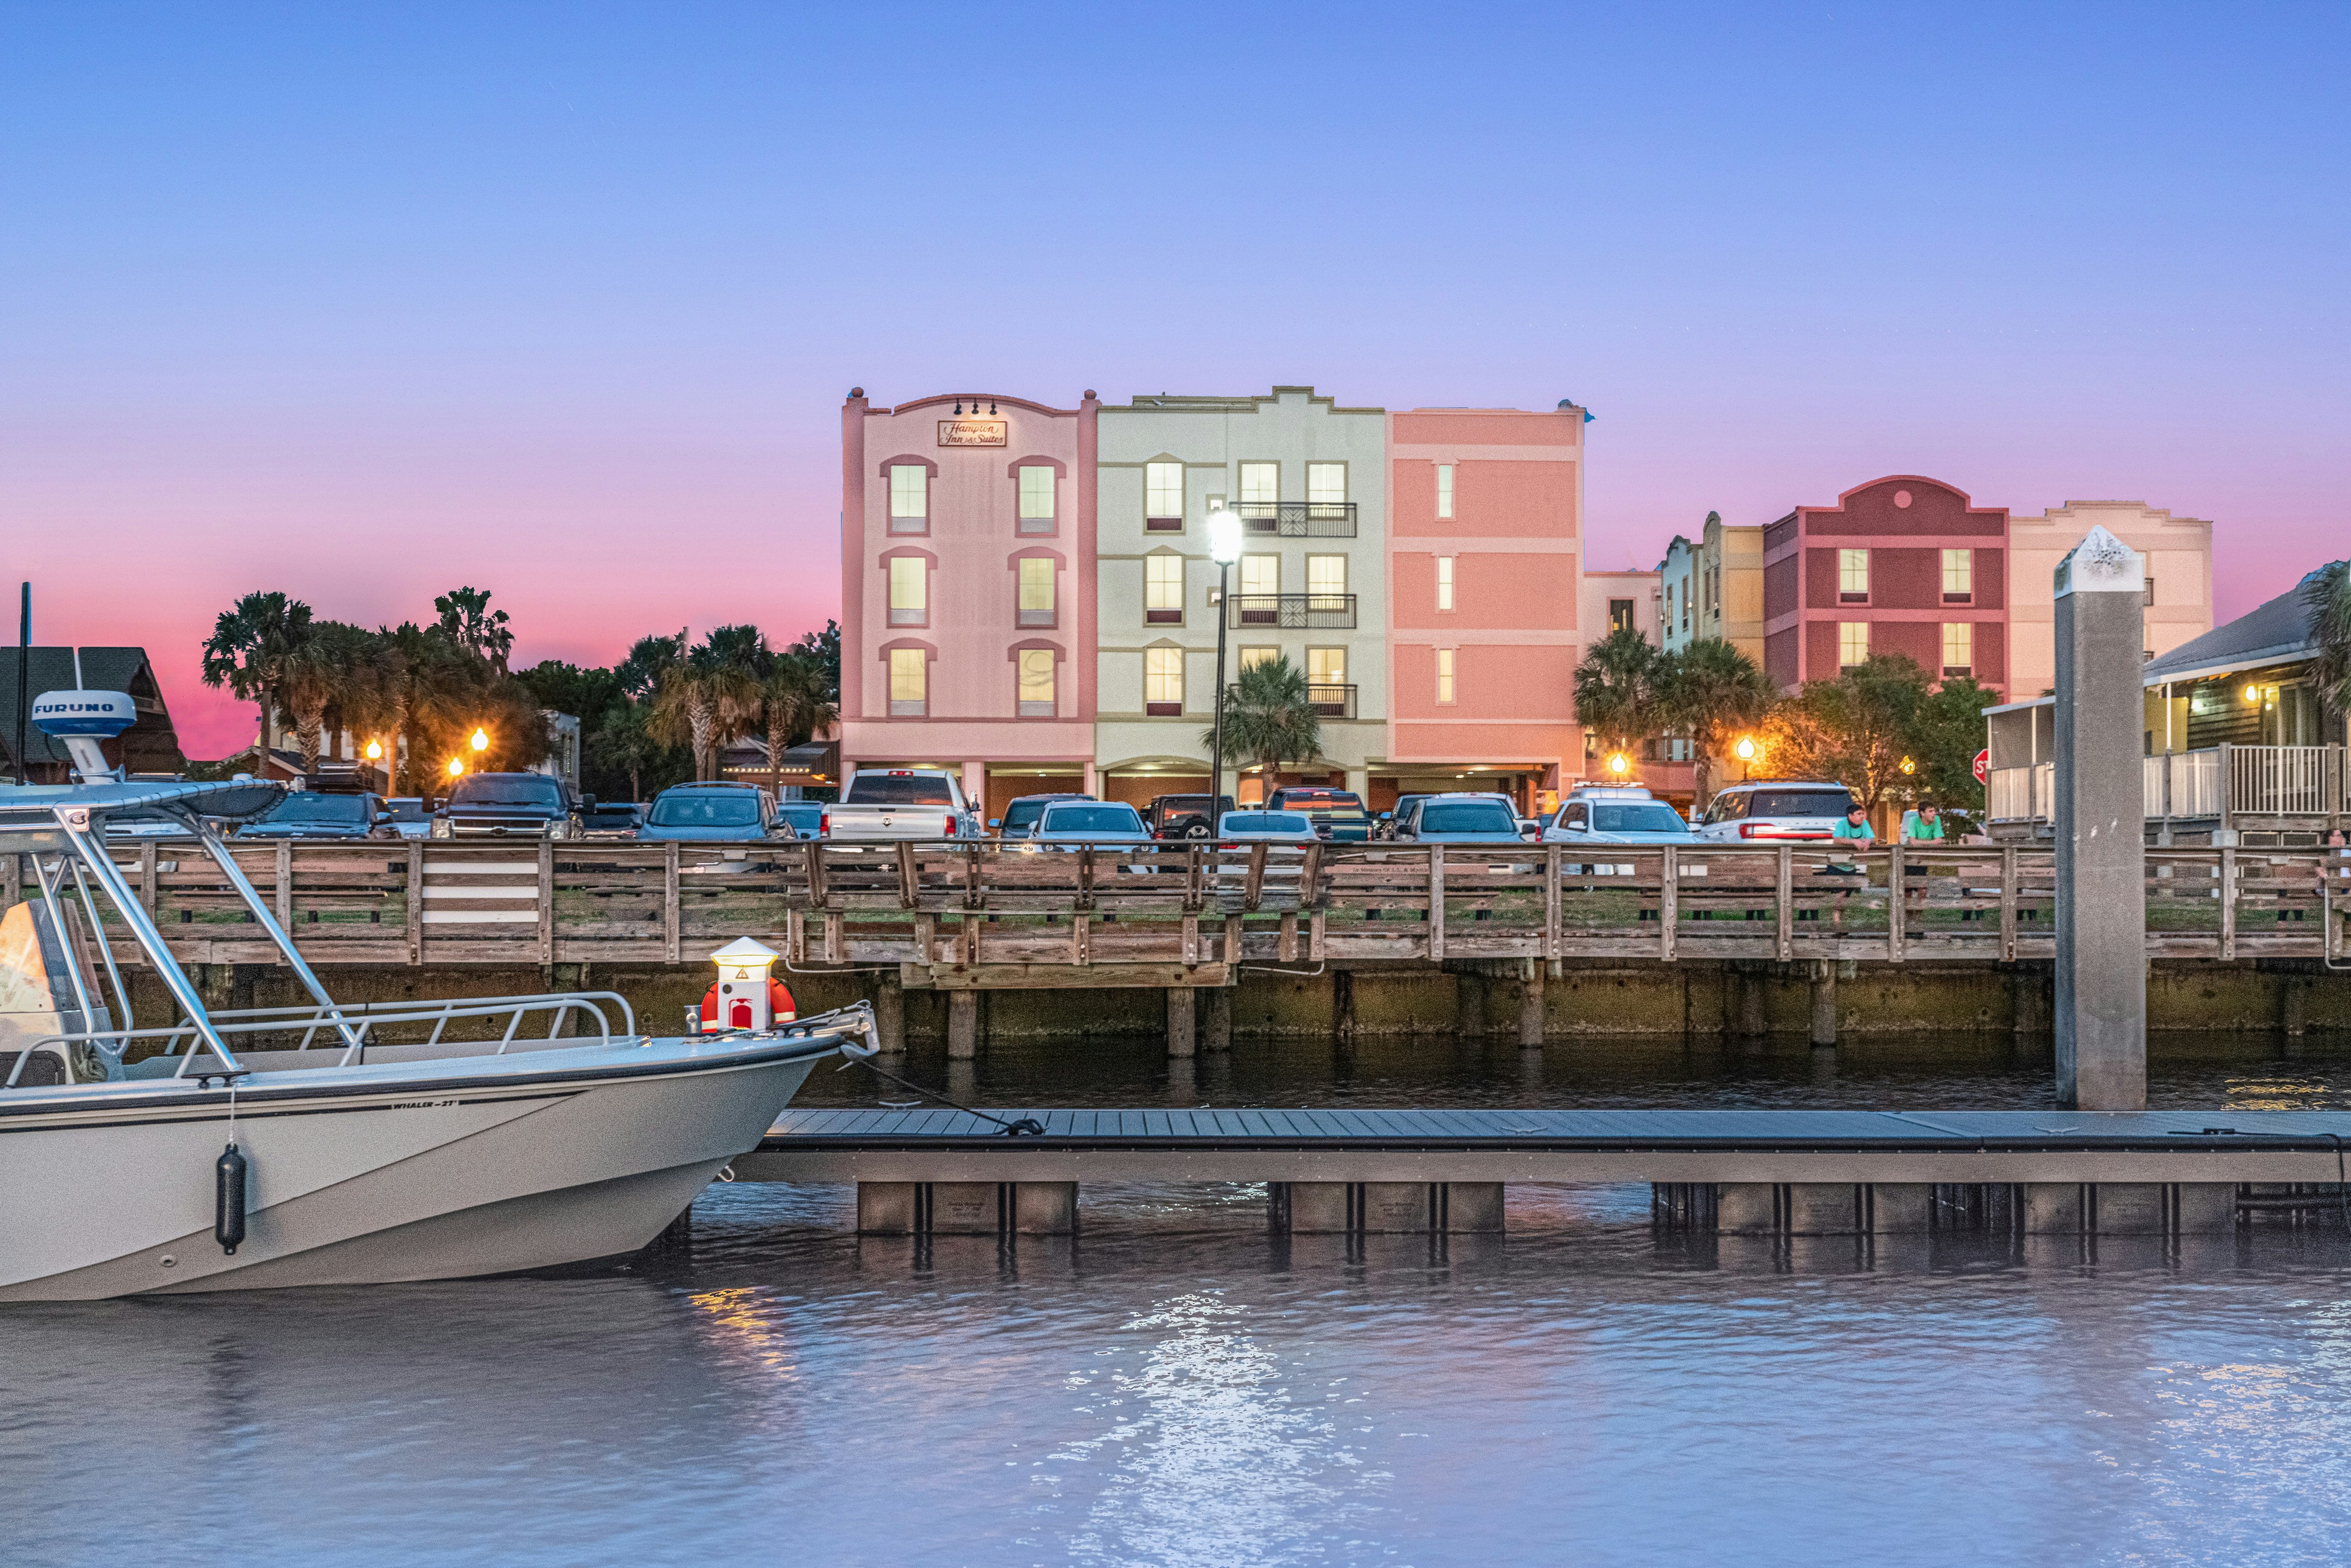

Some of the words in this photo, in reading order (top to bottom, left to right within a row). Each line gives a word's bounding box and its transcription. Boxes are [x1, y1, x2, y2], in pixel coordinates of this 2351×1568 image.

[943, 423, 999, 434] Hampton
[940, 435, 967, 444] Inn
[975, 434, 1003, 444] Suites
[35, 704, 113, 713] FURUNO
